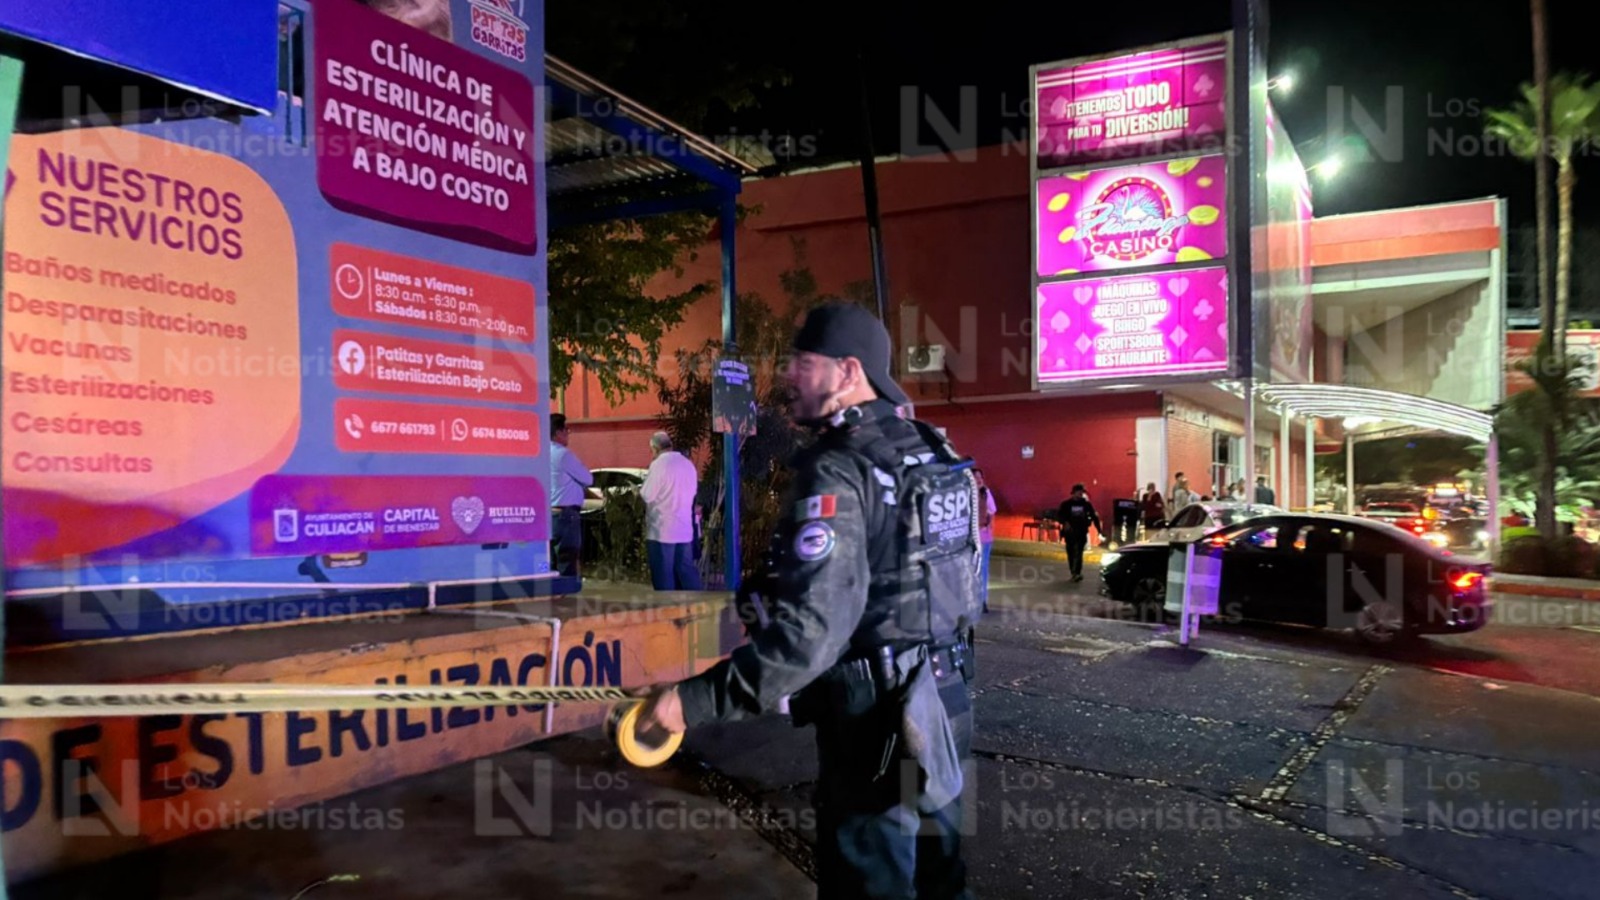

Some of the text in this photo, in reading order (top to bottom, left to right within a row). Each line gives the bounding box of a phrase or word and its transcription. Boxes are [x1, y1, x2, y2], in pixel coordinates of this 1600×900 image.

[371, 39, 493, 106] CLÍNICA DE
[326, 59, 526, 151] ESTERILIZACIÓN Y
[1124, 81, 1170, 111] TODO
[1067, 105, 1189, 141] PARA TU DIVERSIÓN!
[323, 98, 528, 185] ATENCIÓN MÉDICA
[37, 147, 244, 225] NUESTROS
[353, 147, 510, 211] A BAJO COSTO
[39, 190, 244, 260] SERVICIOS
[1090, 234, 1173, 256] CASINO
[4, 250, 238, 306] Baños medicados
[374, 266, 412, 286] Lunes
[414, 277, 422, 288] a
[424, 276, 468, 296] Viernes
[375, 283, 400, 299] 8:30
[7, 291, 249, 341] Desparasitaciones
[375, 300, 427, 321] Sábados
[1091, 298, 1168, 318] JUEGO EN VIVO
[9, 331, 133, 363] Vacunas
[1096, 333, 1163, 351] SPORTSBOOK
[376, 345, 485, 371] Patitas y Garritas
[1094, 349, 1167, 368] RESTAURANTE
[9, 372, 215, 406] Esterilizaciones
[376, 365, 522, 393] Esterilización Bajo Costo
[10, 412, 143, 437] Cesáreas
[371, 421, 397, 435] 6677
[12, 450, 153, 474] Consultas
[383, 508, 439, 523] CAPITAL
[489, 506, 537, 518] HUELLITA
[928, 490, 972, 522] SSP
[304, 520, 375, 537] CULIACÁN
[383, 522, 440, 534] DE BIENESTAR
